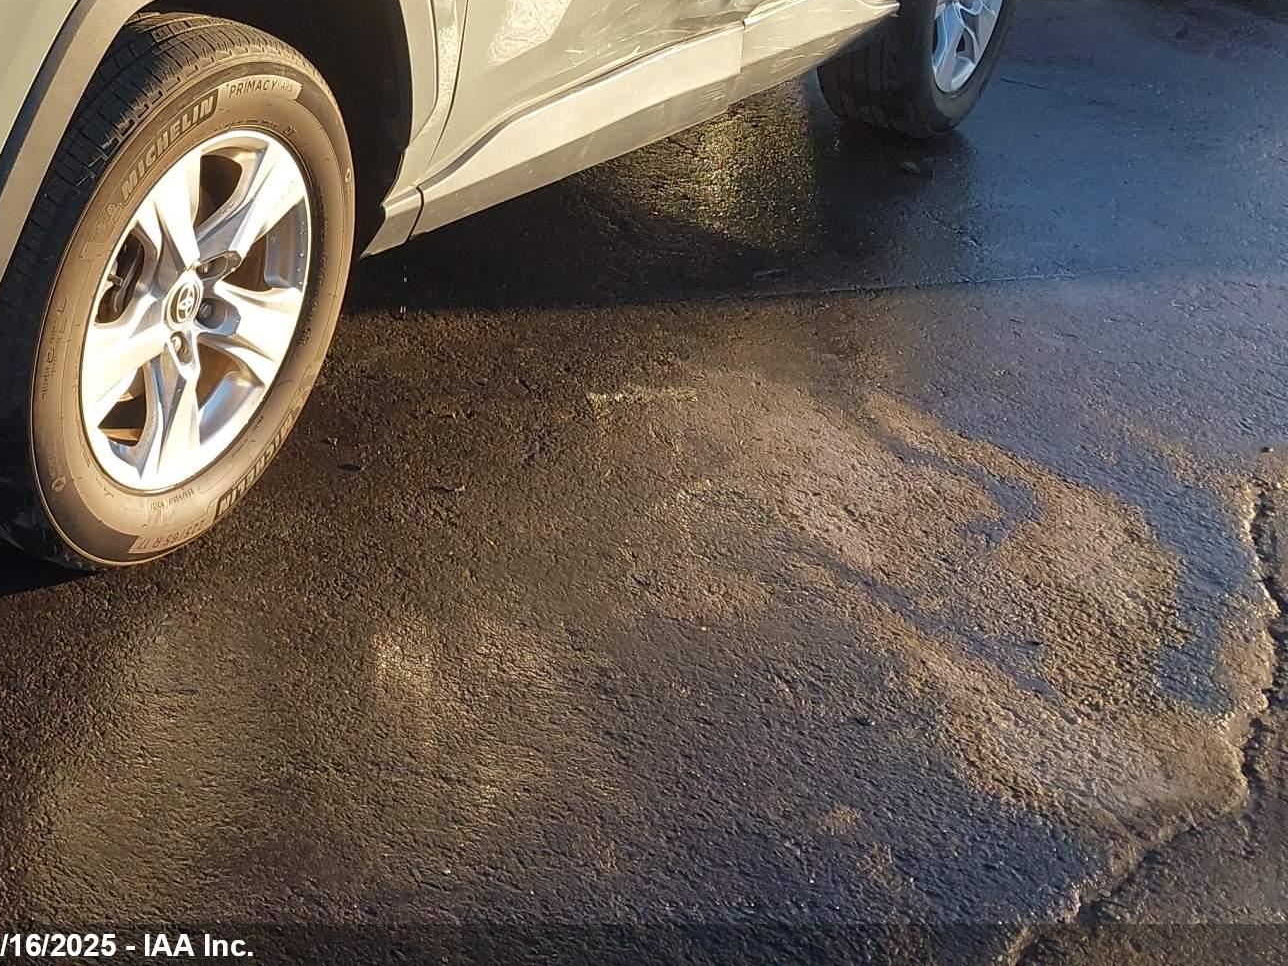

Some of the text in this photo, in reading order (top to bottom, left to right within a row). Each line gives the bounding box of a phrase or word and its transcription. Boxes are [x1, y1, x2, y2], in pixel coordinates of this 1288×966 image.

[121, 94, 217, 202] MICHELIN
[228, 80, 277, 98] PRIMACY
[215, 411, 295, 519] MICHELIN
